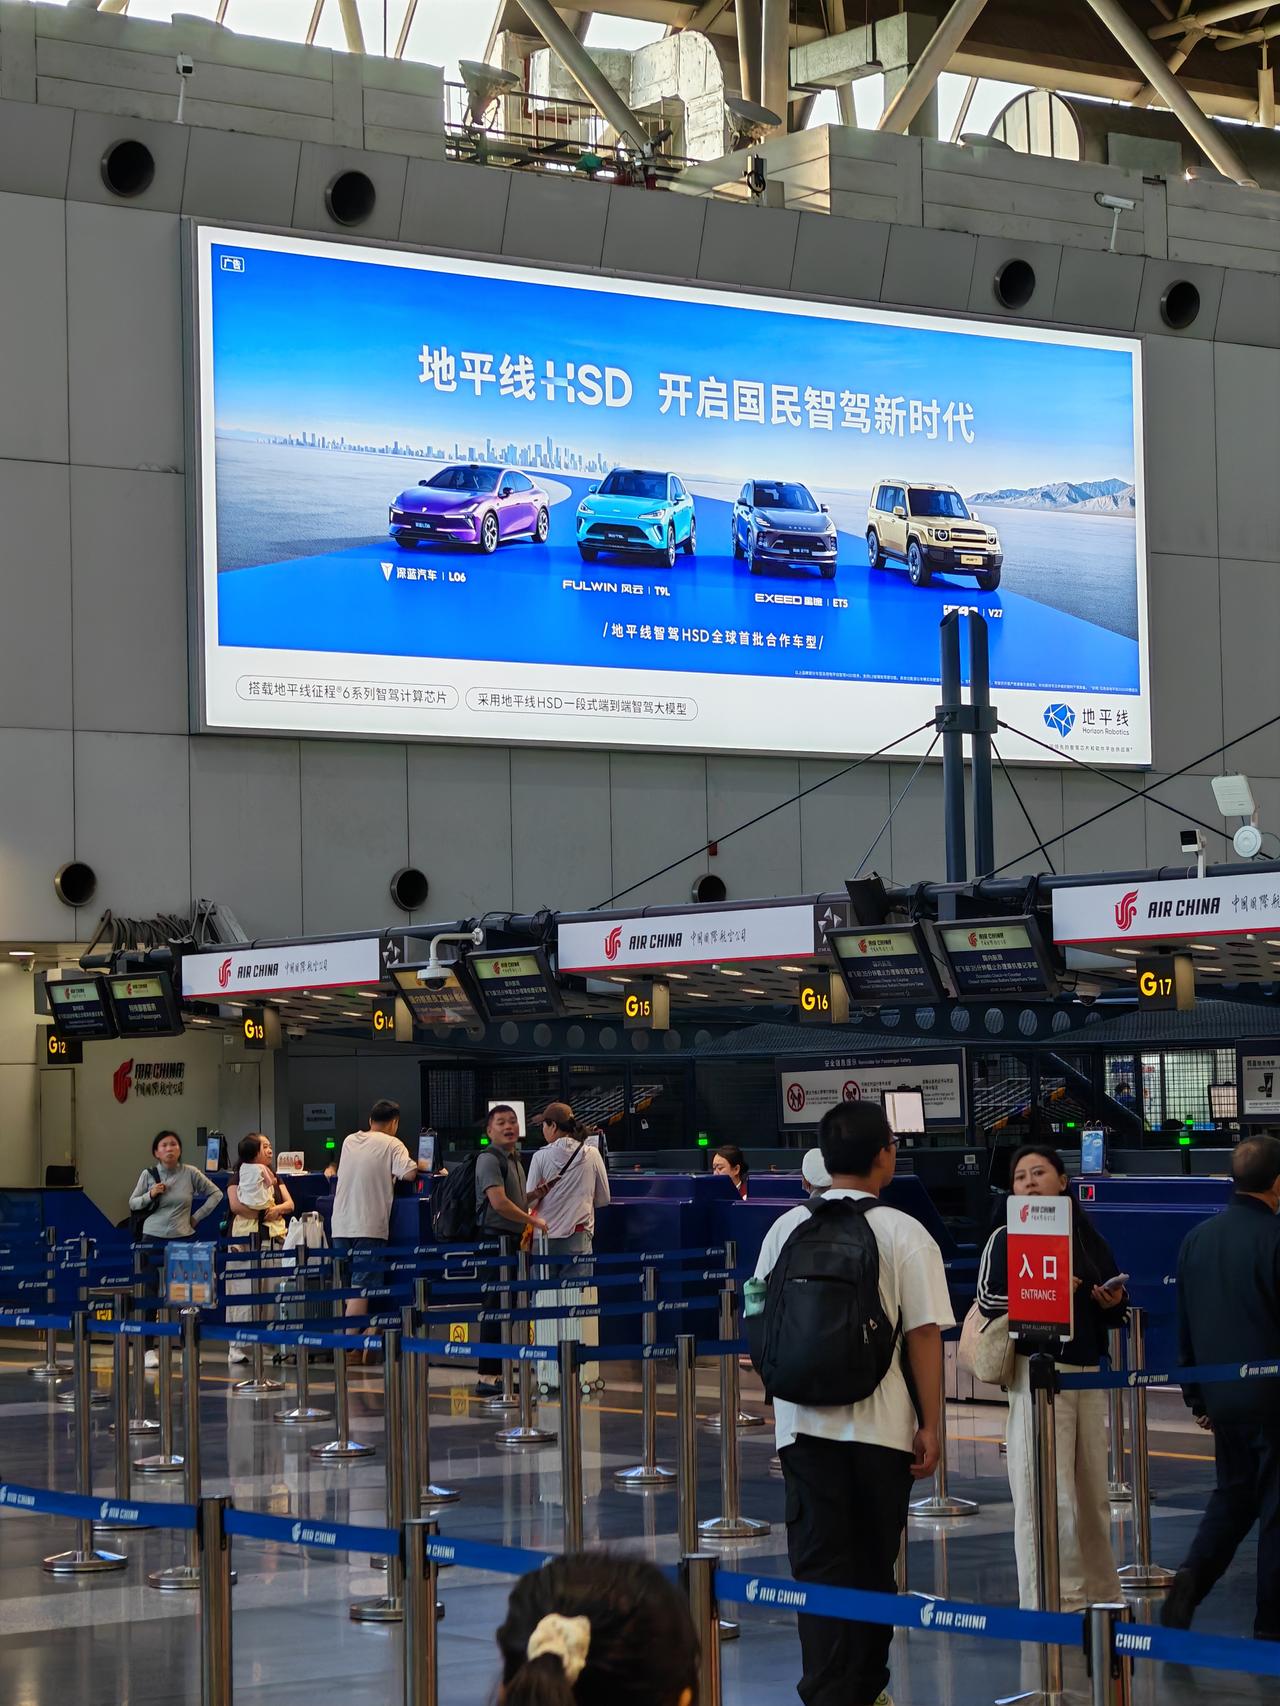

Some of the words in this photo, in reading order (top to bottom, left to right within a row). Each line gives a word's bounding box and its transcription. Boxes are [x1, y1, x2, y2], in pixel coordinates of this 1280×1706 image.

[418, 344, 633, 408] 地平线HSD
[658, 372, 976, 444] 开启国民智驾新时代
[396, 566, 437, 581] 深蓝汽车
[448, 571, 467, 582] L06
[562, 579, 618, 593] FULWIN
[621, 583, 644, 595] 风云
[654, 586, 671, 596] T9L
[755, 593, 802, 605] EXEED
[832, 598, 849, 608] ET5
[988, 608, 1003, 618] V27
[477, 693, 688, 716] 采用地平线HSD一段式端到端智驾大模型
[1082, 708, 1129, 727] 地平线
[1082, 727, 1104, 735] Horizon
[1104, 728, 1130, 736] Robotics
[1147, 900, 1173, 919] AIR
[1175, 897, 1221, 917] CHINA
[628, 935, 647, 950] AIR
[649, 932, 683, 949] CHINA
[237, 965, 251, 979] AIR
[253, 963, 279, 978] CHINA
[1140, 971, 1172, 997] G17
[625, 995, 650, 1017] G15
[801, 987, 829, 1012] G16
[244, 1018, 264, 1039] G13
[373, 1010, 394, 1031] G14
[48, 1035, 66, 1054] G12
[134, 1063, 152, 1079] AIR
[152, 1062, 185, 1079] CHINA
[1018, 1253, 1057, 1281] 入口
[1020, 1288, 1057, 1301] ENTRANCE
[533, 1350, 548, 1358] CHINA
[1259, 1365, 1279, 1374] CHINA
[1148, 1374, 1169, 1383] CHINA
[6, 1492, 17, 1503] AIR
[17, 1494, 36, 1506] CHINA
[108, 1507, 120, 1519] AIR
[119, 1509, 140, 1521] CHINA
[300, 1529, 315, 1541] AIR
[314, 1531, 337, 1544] CHINA
[432, 1546, 455, 1559] CHINA
[759, 1587, 776, 1601] AIR
[776, 1590, 807, 1605] CHINA
[935, 1611, 955, 1626] AIR
[954, 1613, 987, 1629] CHINA
[1115, 1633, 1152, 1651] CHINA
